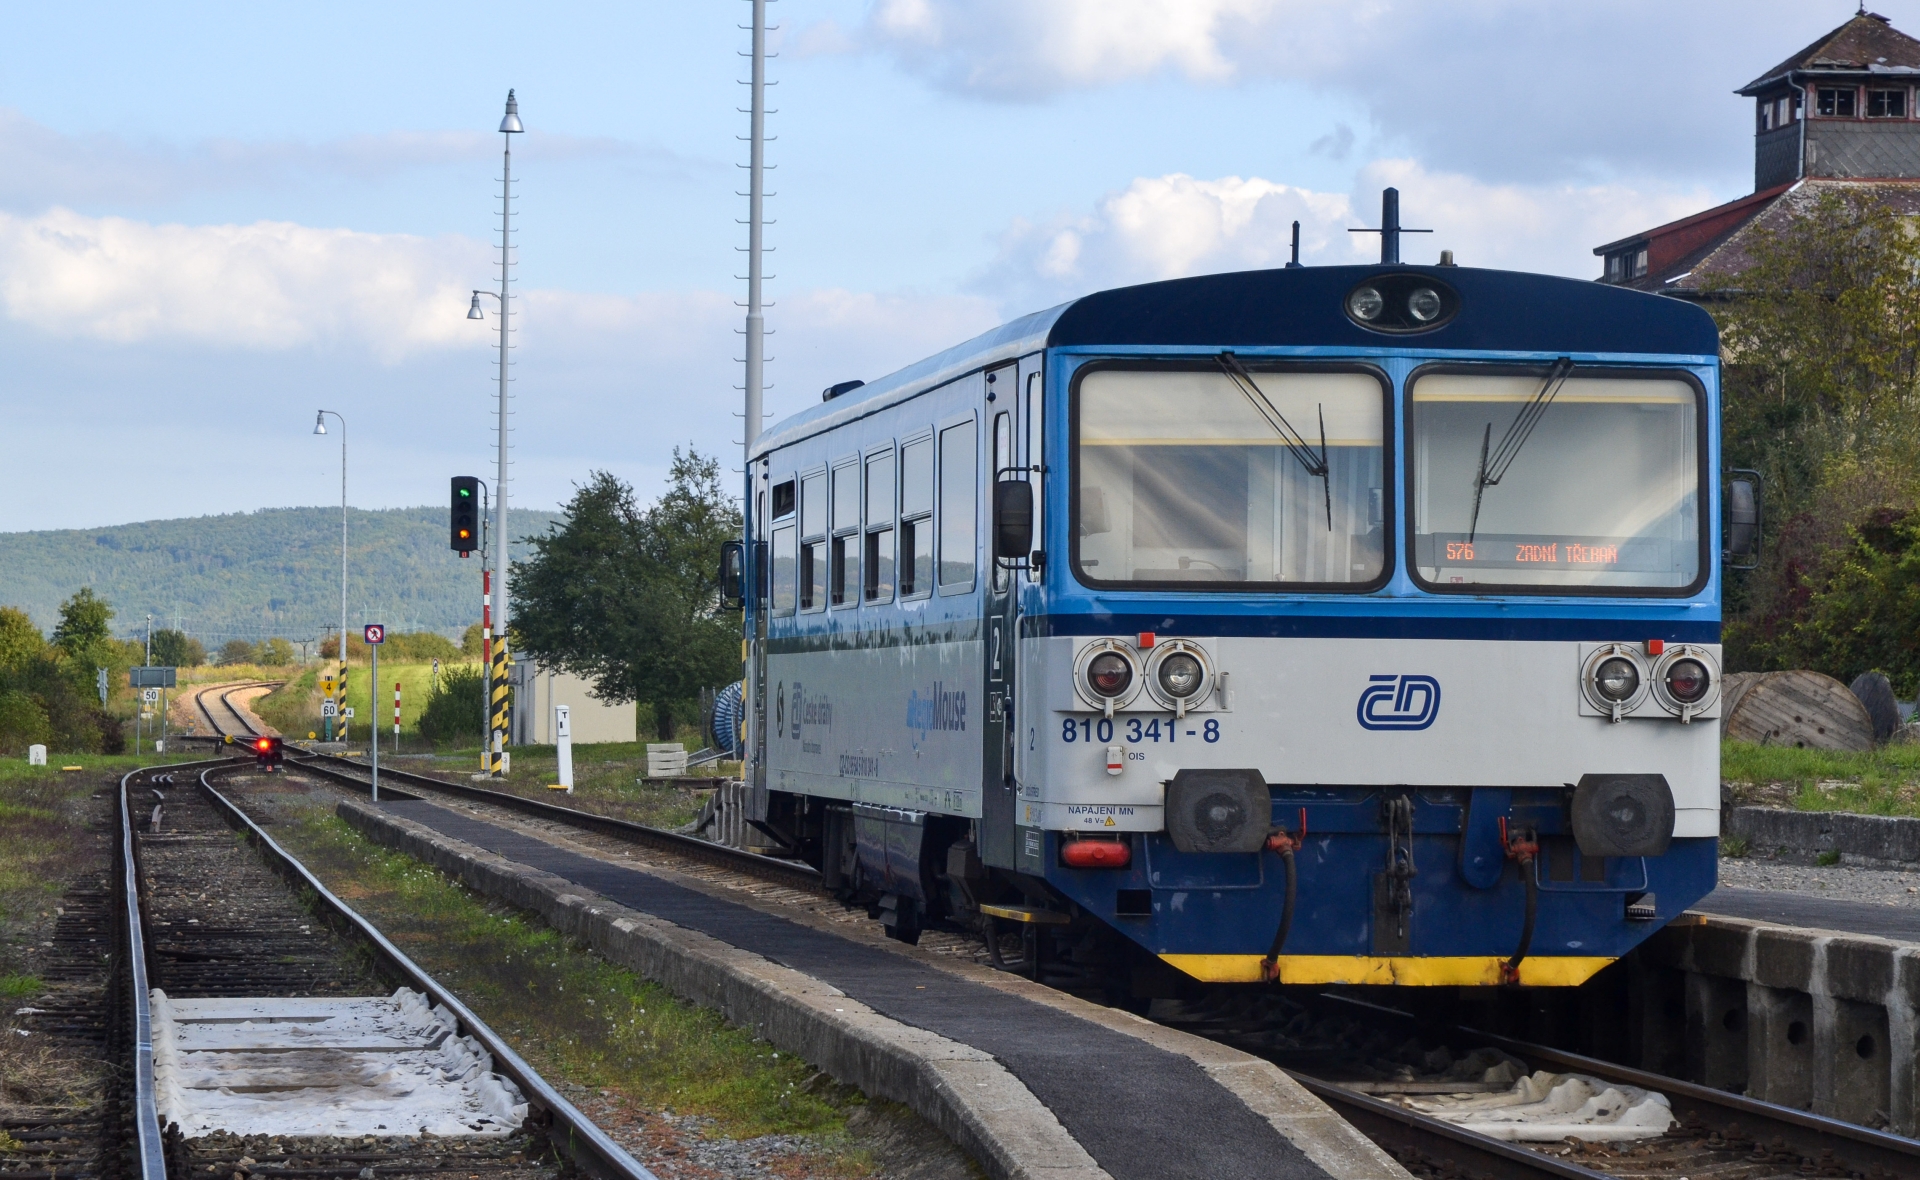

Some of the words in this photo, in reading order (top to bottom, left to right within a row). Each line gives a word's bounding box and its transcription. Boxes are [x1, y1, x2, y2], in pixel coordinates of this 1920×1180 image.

[1446, 543, 1475, 560] S76
[1515, 542, 1557, 562] ZADNÍ
[993, 626, 1000, 670] 2
[145, 691, 157, 700] 50
[326, 683, 332, 691] 4
[324, 705, 335, 715] 60
[1356, 674, 1442, 731] ČD
[1030, 727, 1035, 751] 2
[1062, 718, 1114, 743] 810
[1068, 804, 1116, 815] NAPÁJENÍ
[1119, 807, 1134, 815] MN
